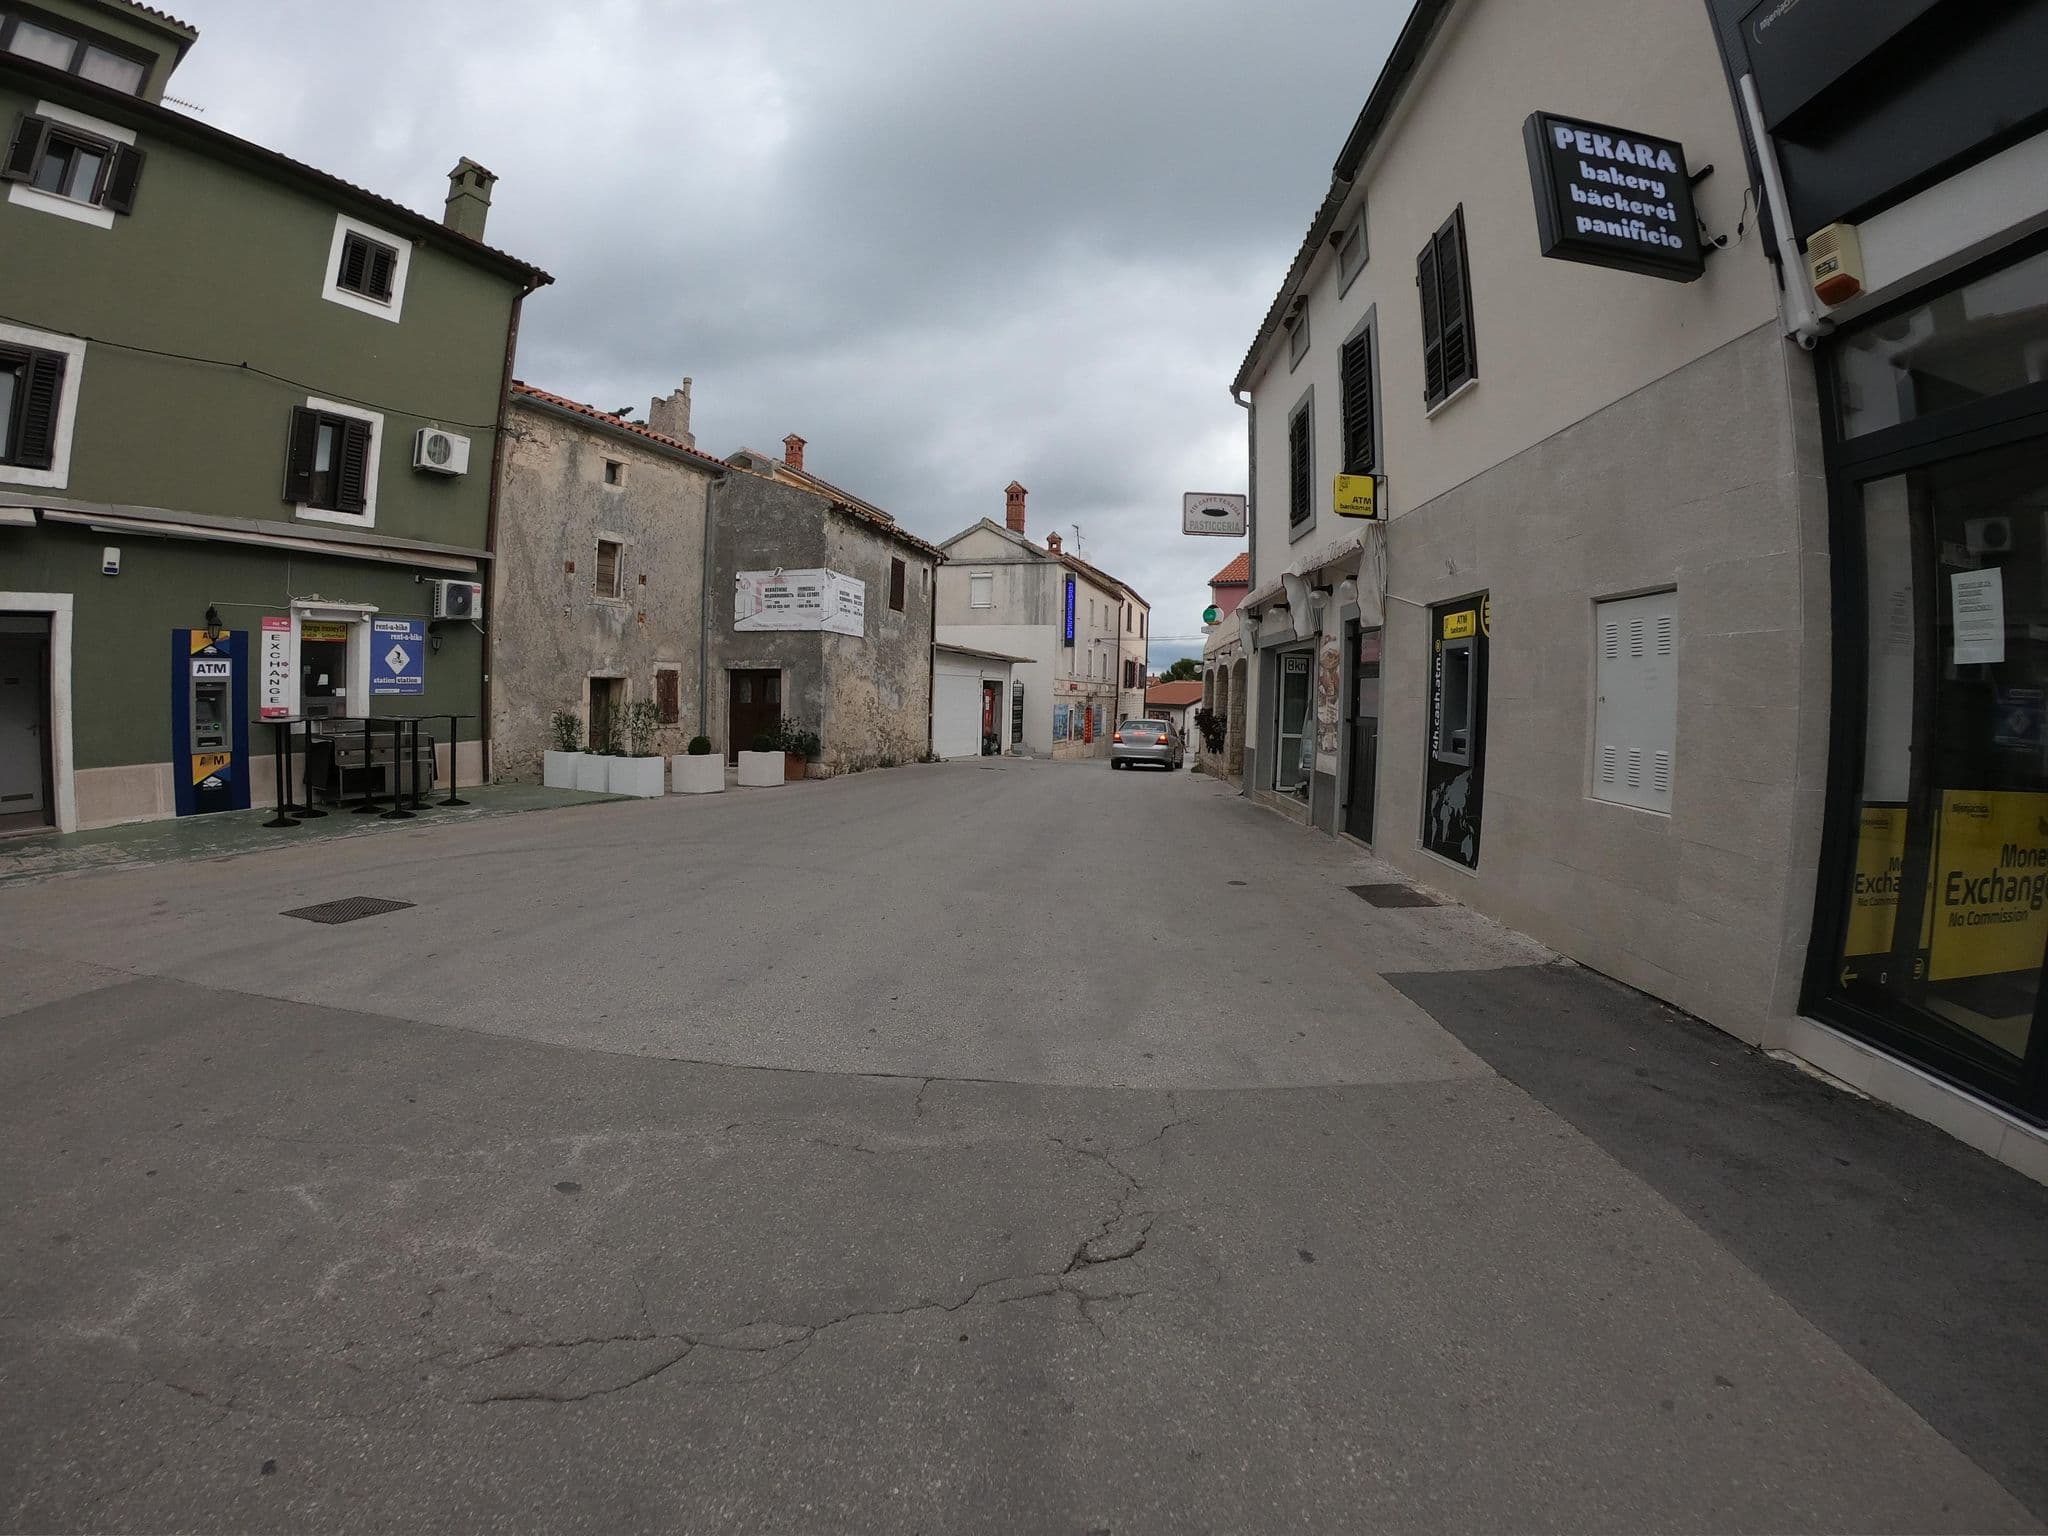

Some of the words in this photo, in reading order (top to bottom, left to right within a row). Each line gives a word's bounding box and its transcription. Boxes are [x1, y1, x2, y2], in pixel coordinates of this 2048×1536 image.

[1553, 126, 1678, 174] PEKARA
[1578, 160, 1667, 200] bakery
[1569, 183, 1678, 222] bäckerei
[1575, 215, 1684, 249] panificio
[1352, 496, 1372, 505] ATM
[196, 663, 227, 674] ATM
[269, 634, 281, 704] EXCHANGE
[373, 676, 396, 684] station
[1944, 867, 2048, 911] Exchang
[1948, 912, 1965, 928] No
[1966, 907, 2029, 926] Commission
